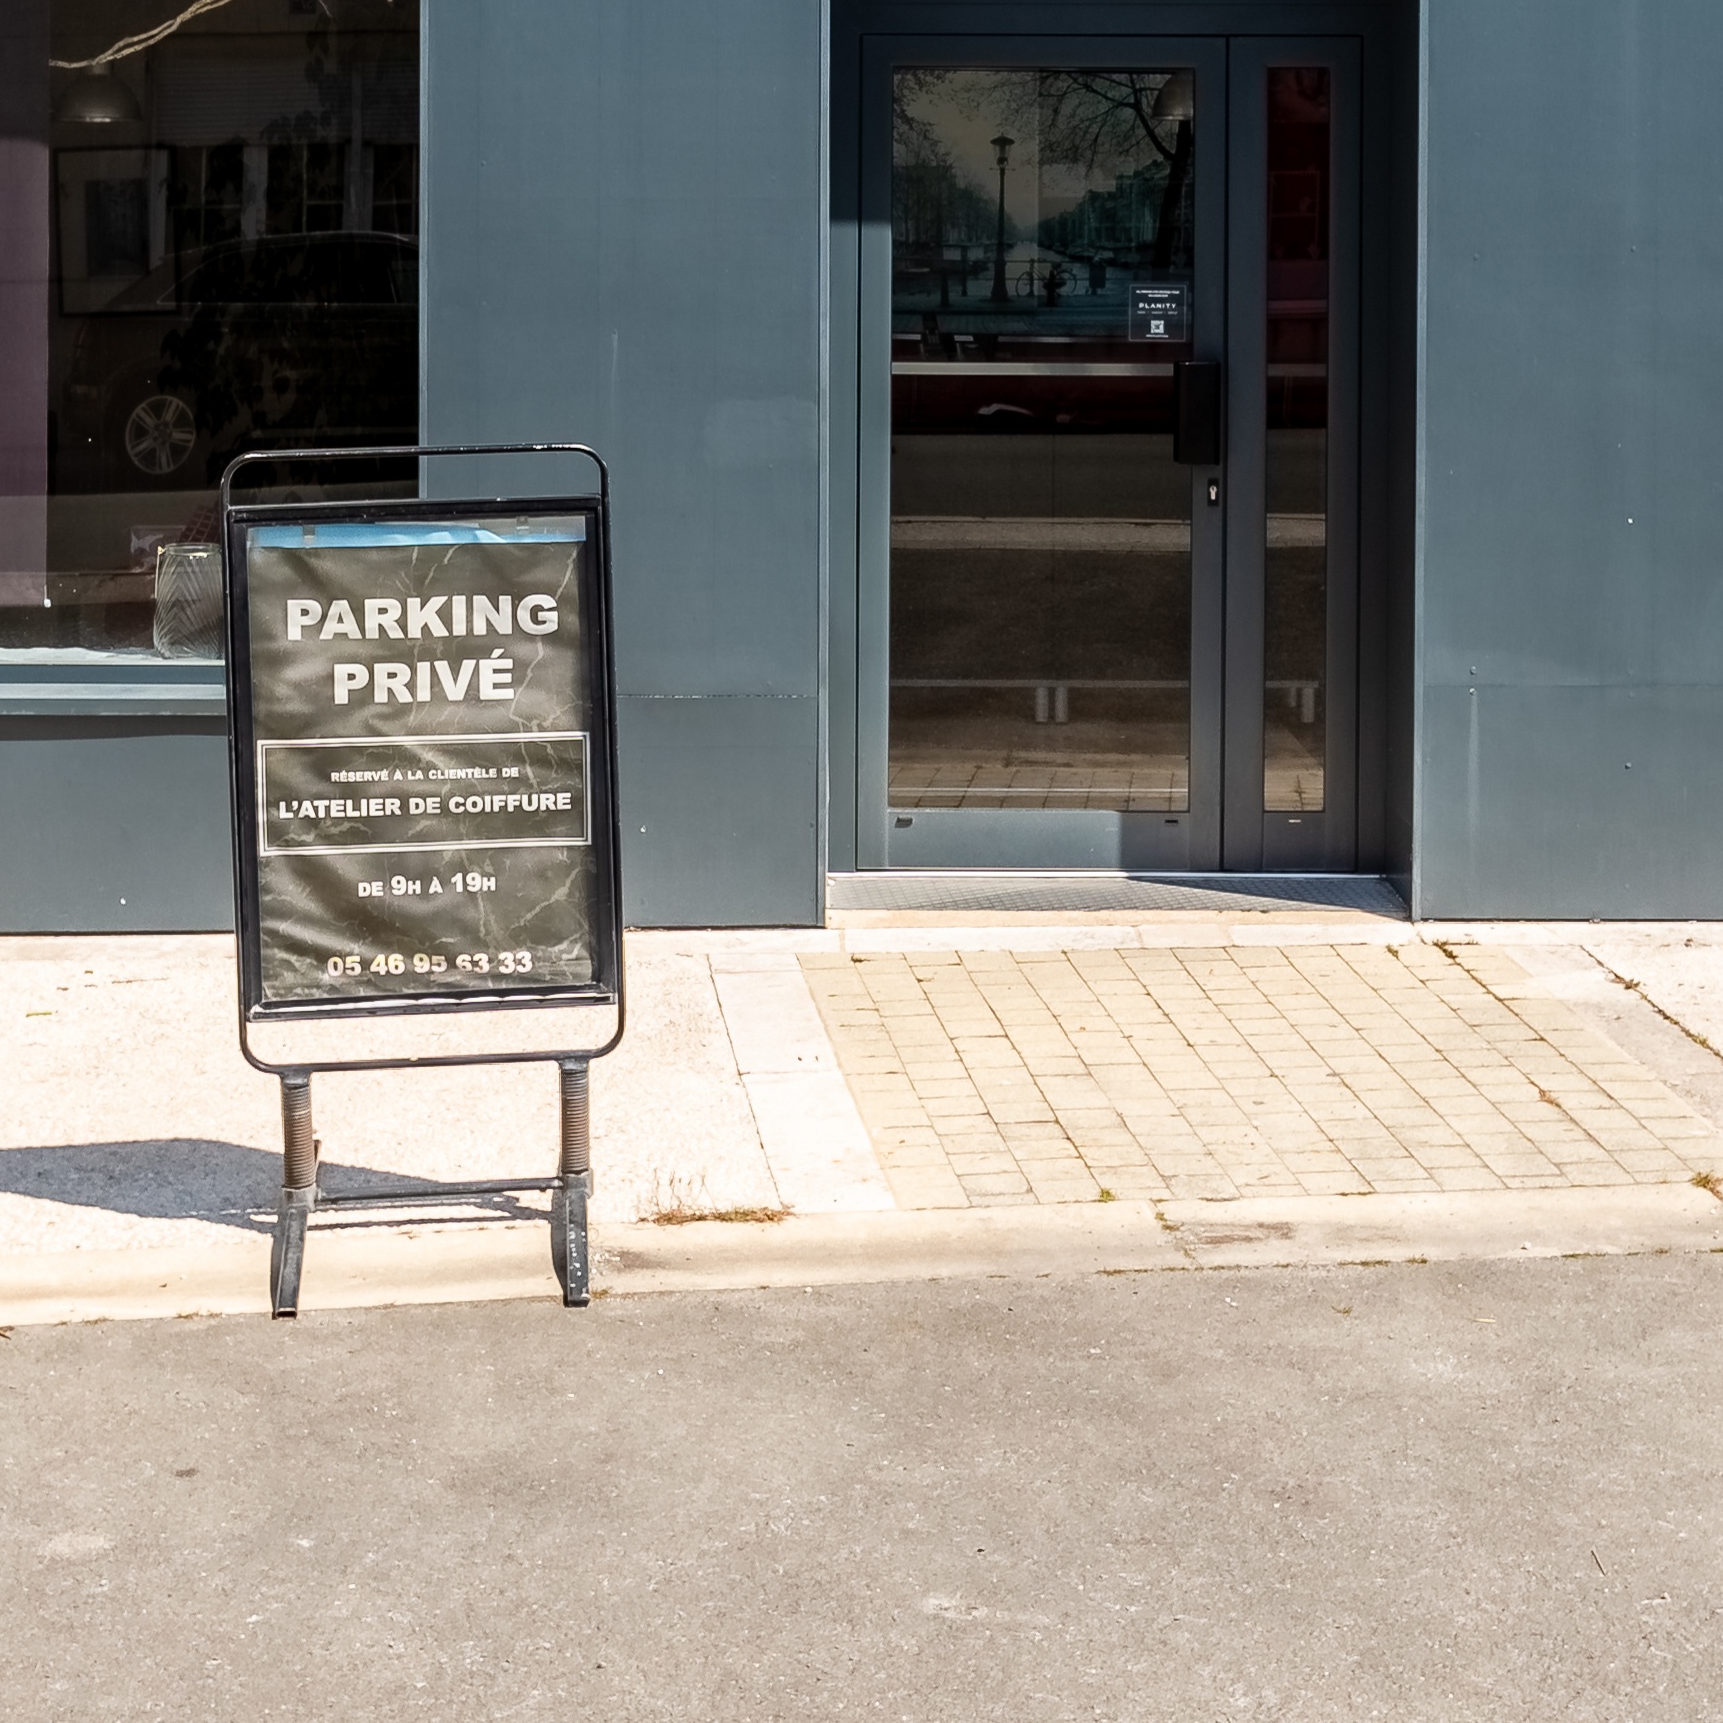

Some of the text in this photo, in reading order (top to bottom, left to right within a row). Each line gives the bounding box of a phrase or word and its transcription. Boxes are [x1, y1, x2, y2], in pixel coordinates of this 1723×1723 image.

[287, 594, 559, 641] PARKING
[333, 647, 515, 705] PRIVÉ
[330, 768, 389, 783] RÉSERVÉ
[393, 768, 404, 782] À
[407, 769, 424, 781] LA
[501, 766, 520, 779] DE
[279, 792, 572, 820] L'ATELIER DE COIFFURE
[357, 881, 384, 898] DE
[428, 876, 444, 895] À
[327, 951, 534, 977] 05 46 95 63 33
